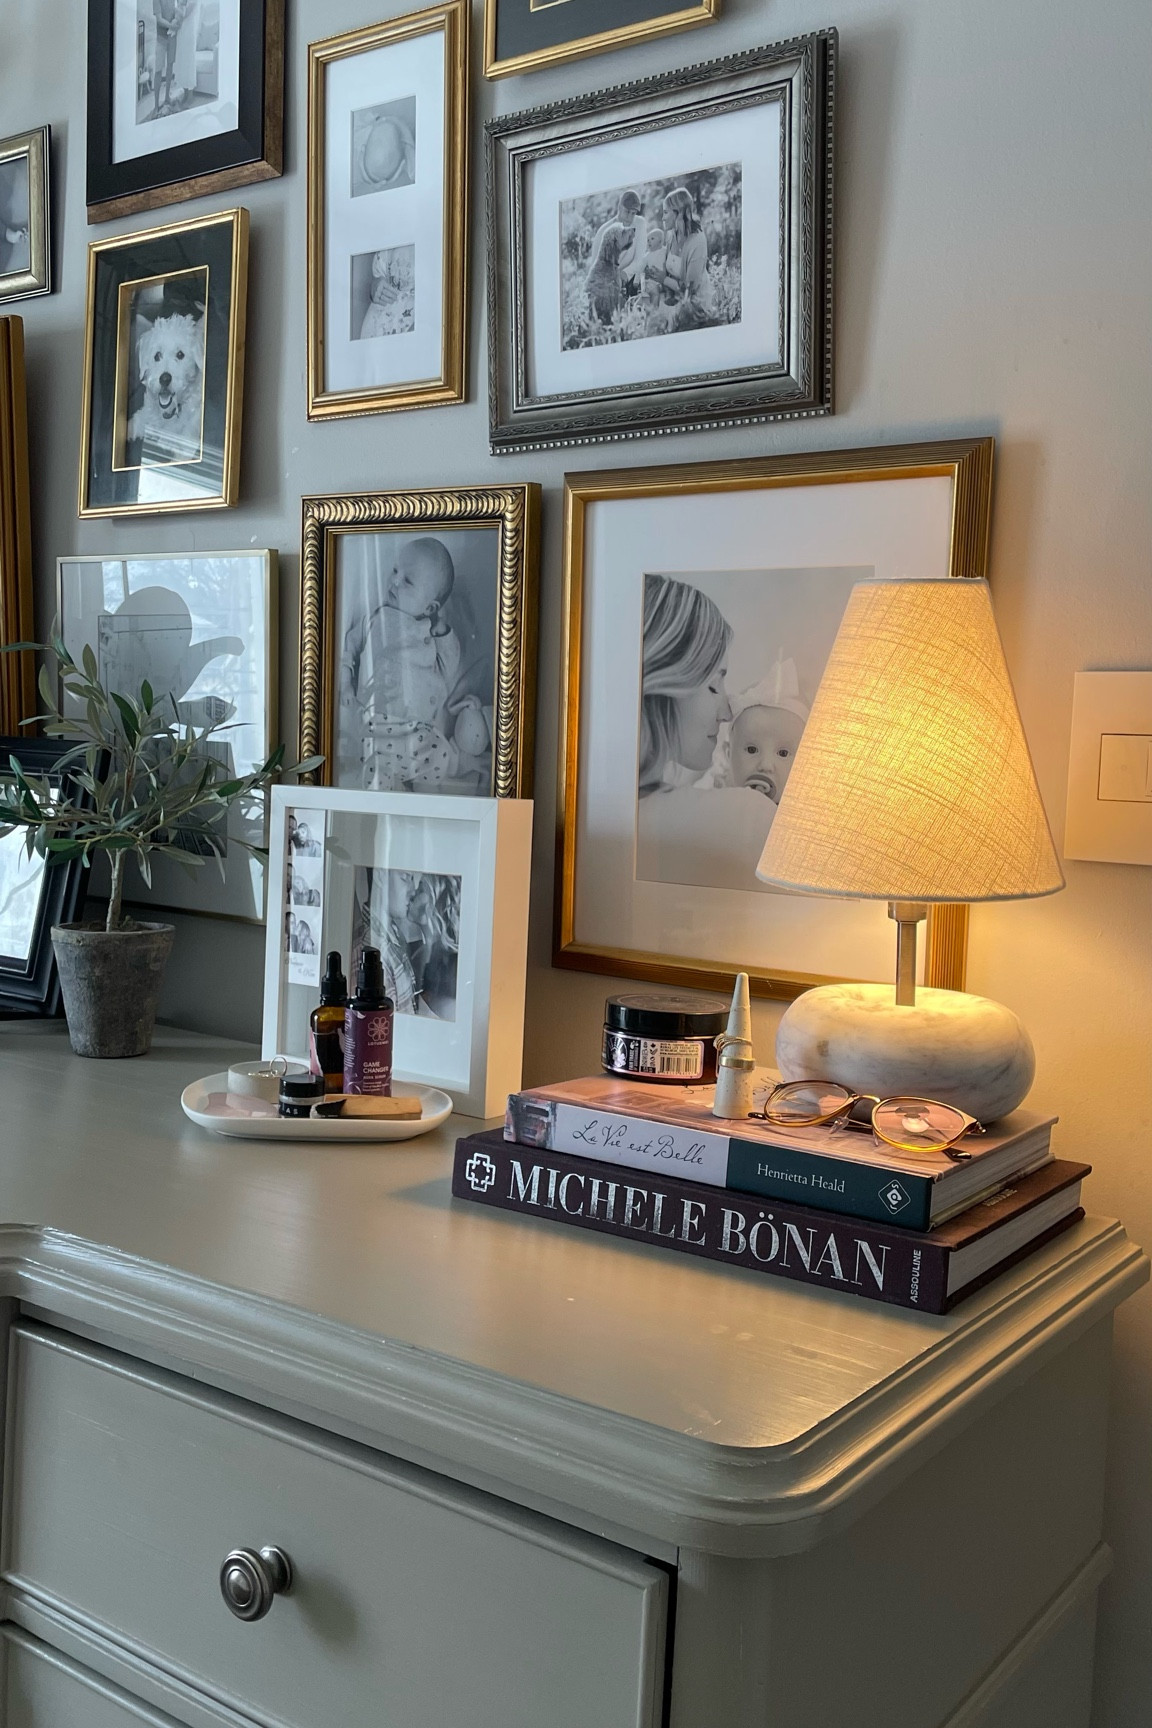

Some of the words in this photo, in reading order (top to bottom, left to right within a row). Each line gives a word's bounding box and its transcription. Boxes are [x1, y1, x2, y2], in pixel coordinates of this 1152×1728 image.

[572, 1120, 598, 1144] La
[601, 1125, 628, 1148] Vie
[627, 1139, 651, 1155] est
[653, 1135, 704, 1165] Belle
[757, 1163, 808, 1186] Henrietta
[811, 1174, 846, 1193] Heald
[507, 1159, 707, 1246] MICHELE
[717, 1207, 892, 1292] BÖNAN
[910, 1249, 922, 1304] ASSOULINE
